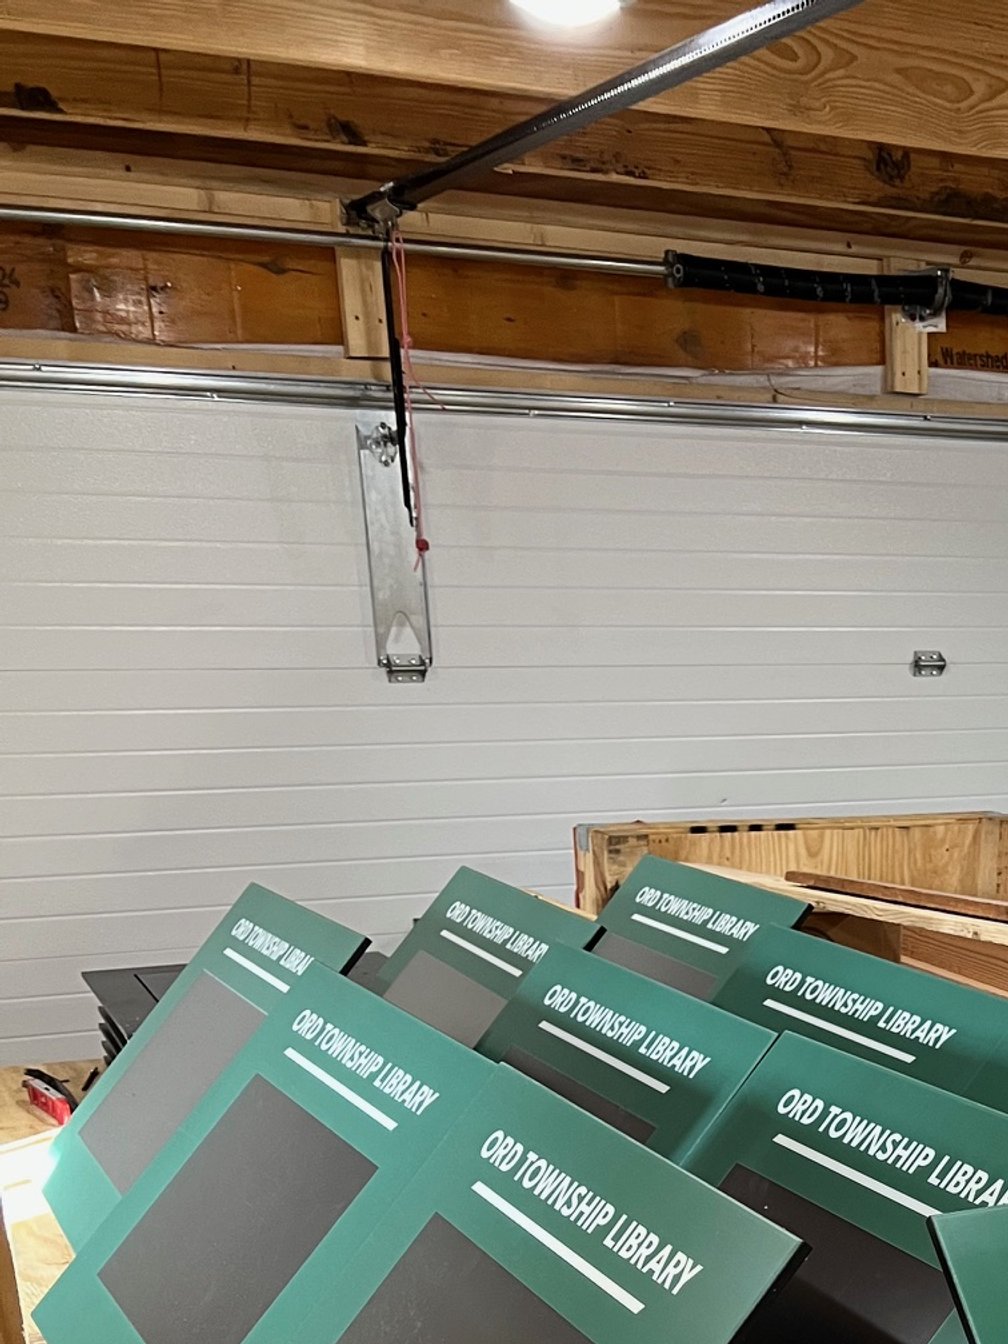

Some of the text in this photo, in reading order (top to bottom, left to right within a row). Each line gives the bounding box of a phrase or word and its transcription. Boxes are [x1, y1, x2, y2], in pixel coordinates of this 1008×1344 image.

[231, 918, 315, 976] ORD TOWNSHIP LIBRA
[445, 900, 550, 964] ORD TOWNSHIP LIBRAR
[635, 886, 760, 942] ORD TOWNSHIP LIBRARY
[543, 984, 711, 1079] ORD TOWNSHIP LIBRARY
[765, 965, 957, 1050] ORD TOWNSHIP LIBRARY
[291, 1009, 440, 1116] ORD TOWNSHIP LIBRARY
[776, 1088, 825, 1125] ORD
[818, 1105, 936, 1175] TOWNSHIP
[480, 1129, 704, 1296] ORD TOWNSHIP LIBRARY
